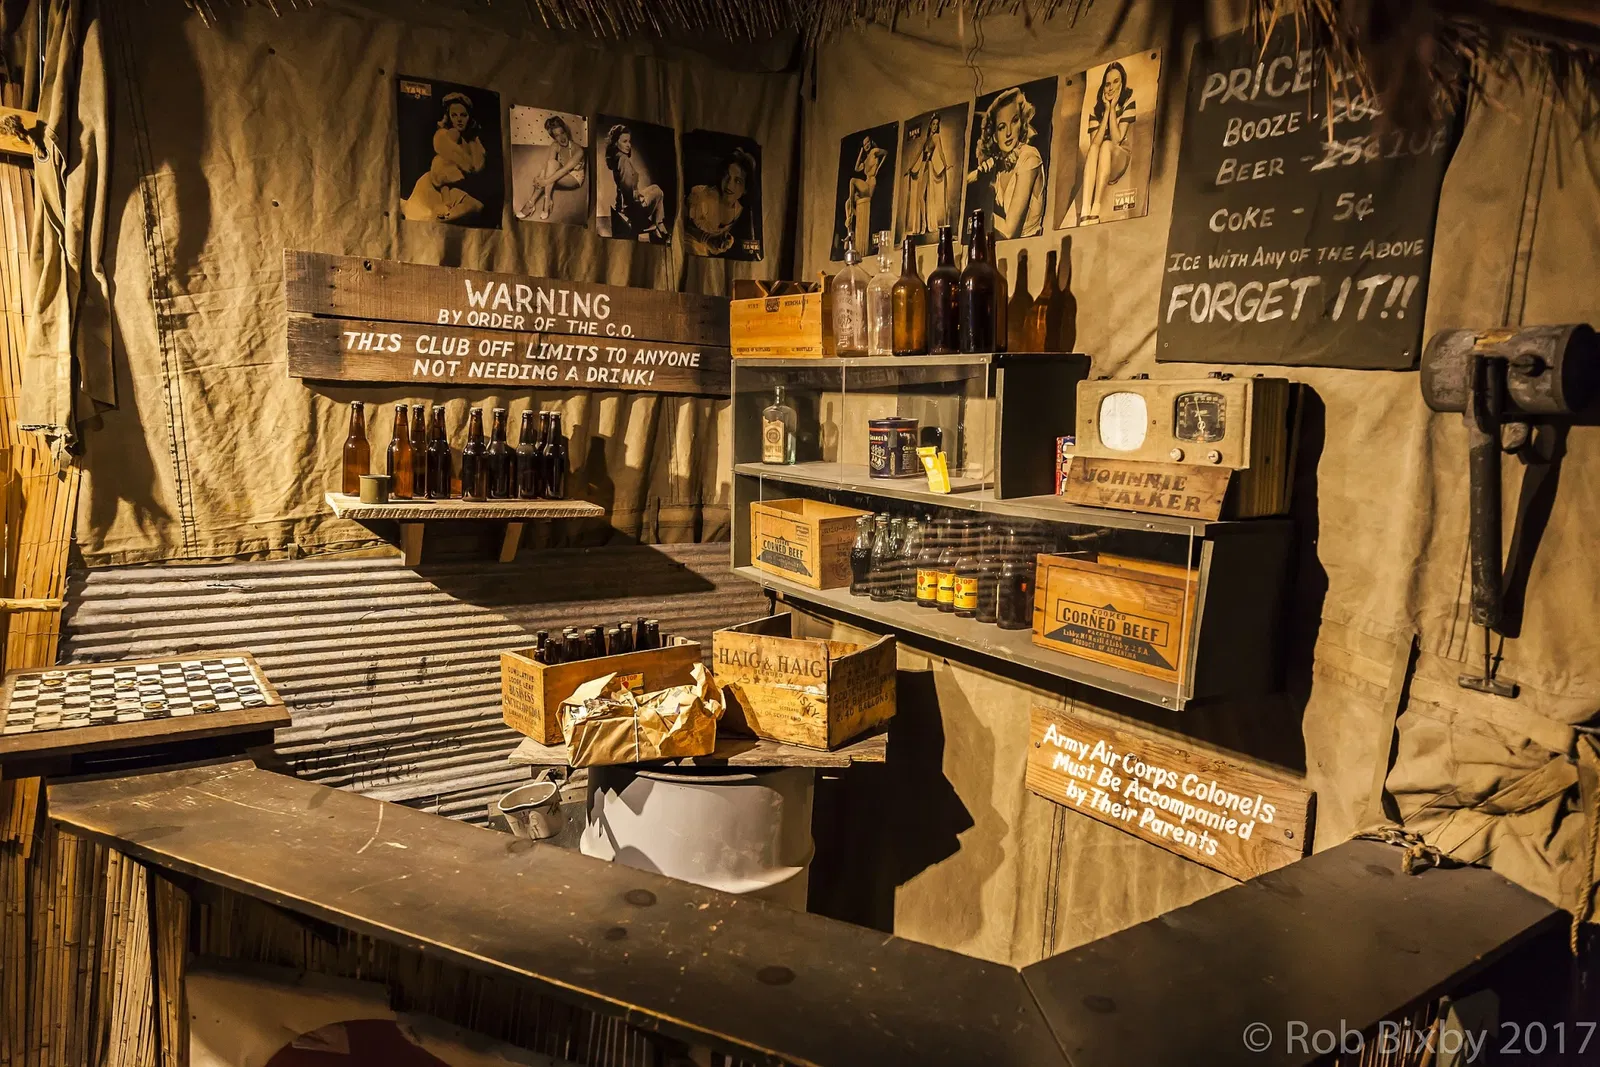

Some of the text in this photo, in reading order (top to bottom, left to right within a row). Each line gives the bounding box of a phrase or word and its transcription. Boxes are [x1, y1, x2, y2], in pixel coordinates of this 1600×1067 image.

[1223, 111, 1302, 147] BOOZE
[1215, 157, 1285, 186] BEER
[1115, 195, 1135, 206] YANK
[1209, 207, 1275, 233] COKE
[1332, 192, 1375, 221] 5¢
[1289, 247, 1309, 264] OF
[1316, 245, 1355, 265] THE
[1360, 238, 1425, 262] ABOVE
[464, 279, 611, 320] WARNING
[1166, 274, 1420, 324] FORGET IT!!
[437, 309, 636, 339] BY ORDER OF THE C.O.
[343, 332, 701, 368] THIS CLUB OFF LIMITS TO ANYONE
[413, 357, 655, 386] NOT NEEDING A DRINK!
[1083, 468, 1188, 492] JOHNNIE
[1097, 487, 1201, 513] WALKER
[763, 540, 804, 559] CORNED BEEF
[1062, 607, 1160, 642] CORNED BEEF
[1092, 608, 1127, 621] COOKED
[719, 647, 761, 668] HAIG
[764, 657, 773, 671] &
[778, 655, 827, 678] HAIG
[1043, 723, 1277, 825] Army Air Corps Colonels
[1052, 752, 1255, 841] Must Be Accompanied
[1066, 779, 1218, 856] by Their Parents
